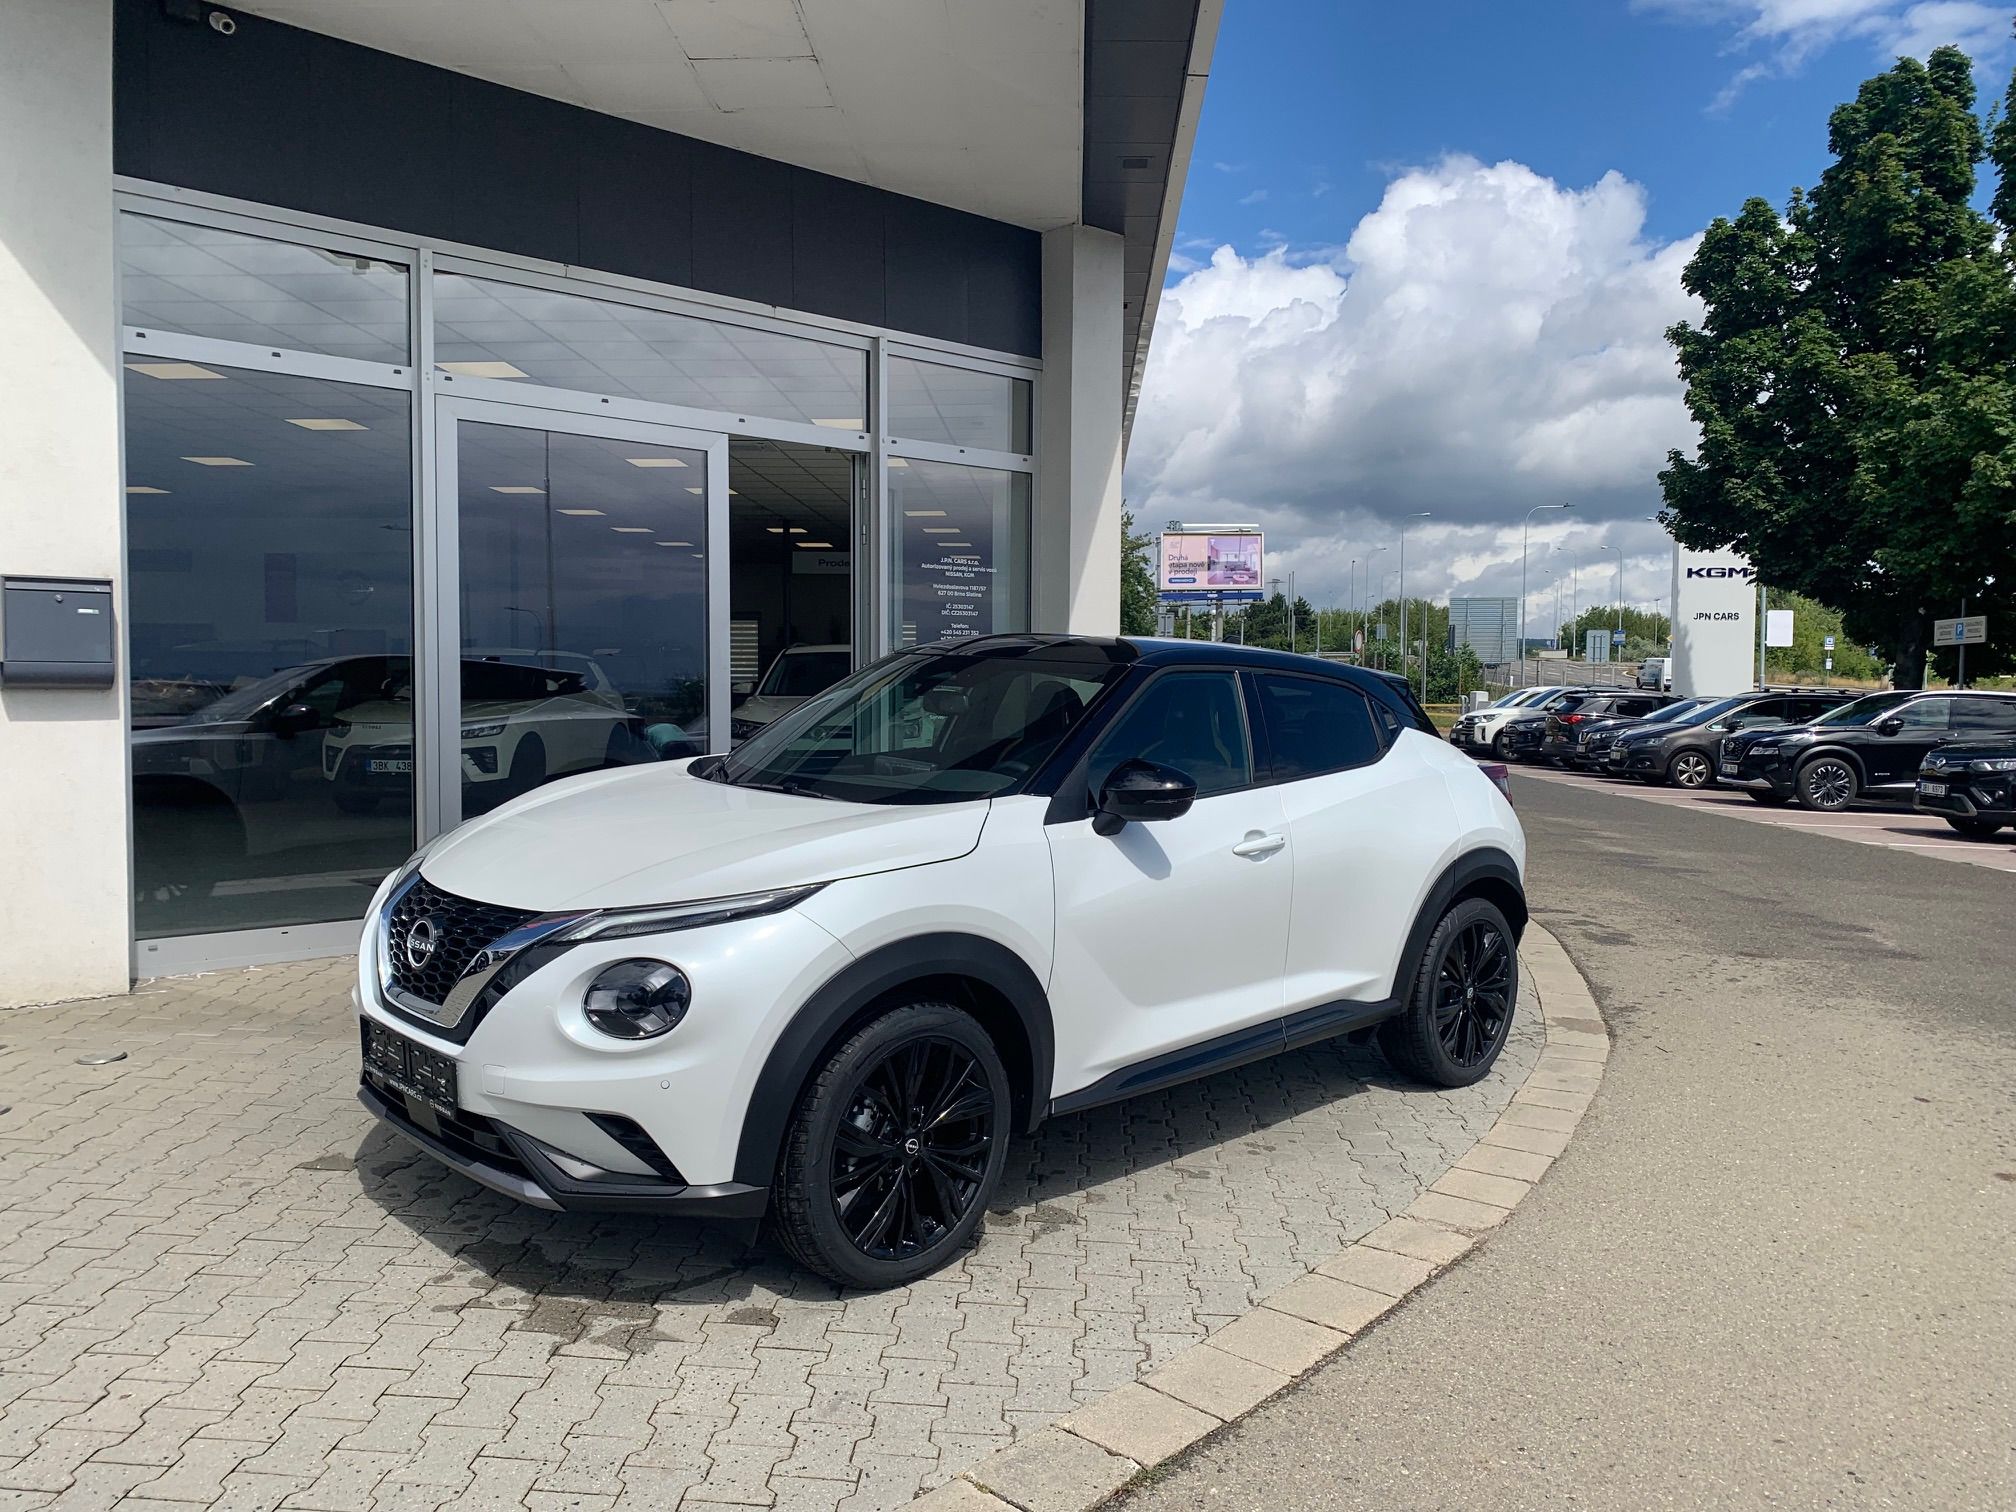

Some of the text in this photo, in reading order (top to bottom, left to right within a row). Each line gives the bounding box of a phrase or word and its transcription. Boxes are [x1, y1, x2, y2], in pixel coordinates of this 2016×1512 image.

[1686, 567, 1750, 578] KGM
[1694, 612, 1740, 621] JPN CARS
[408, 936, 434, 952] SSAN
